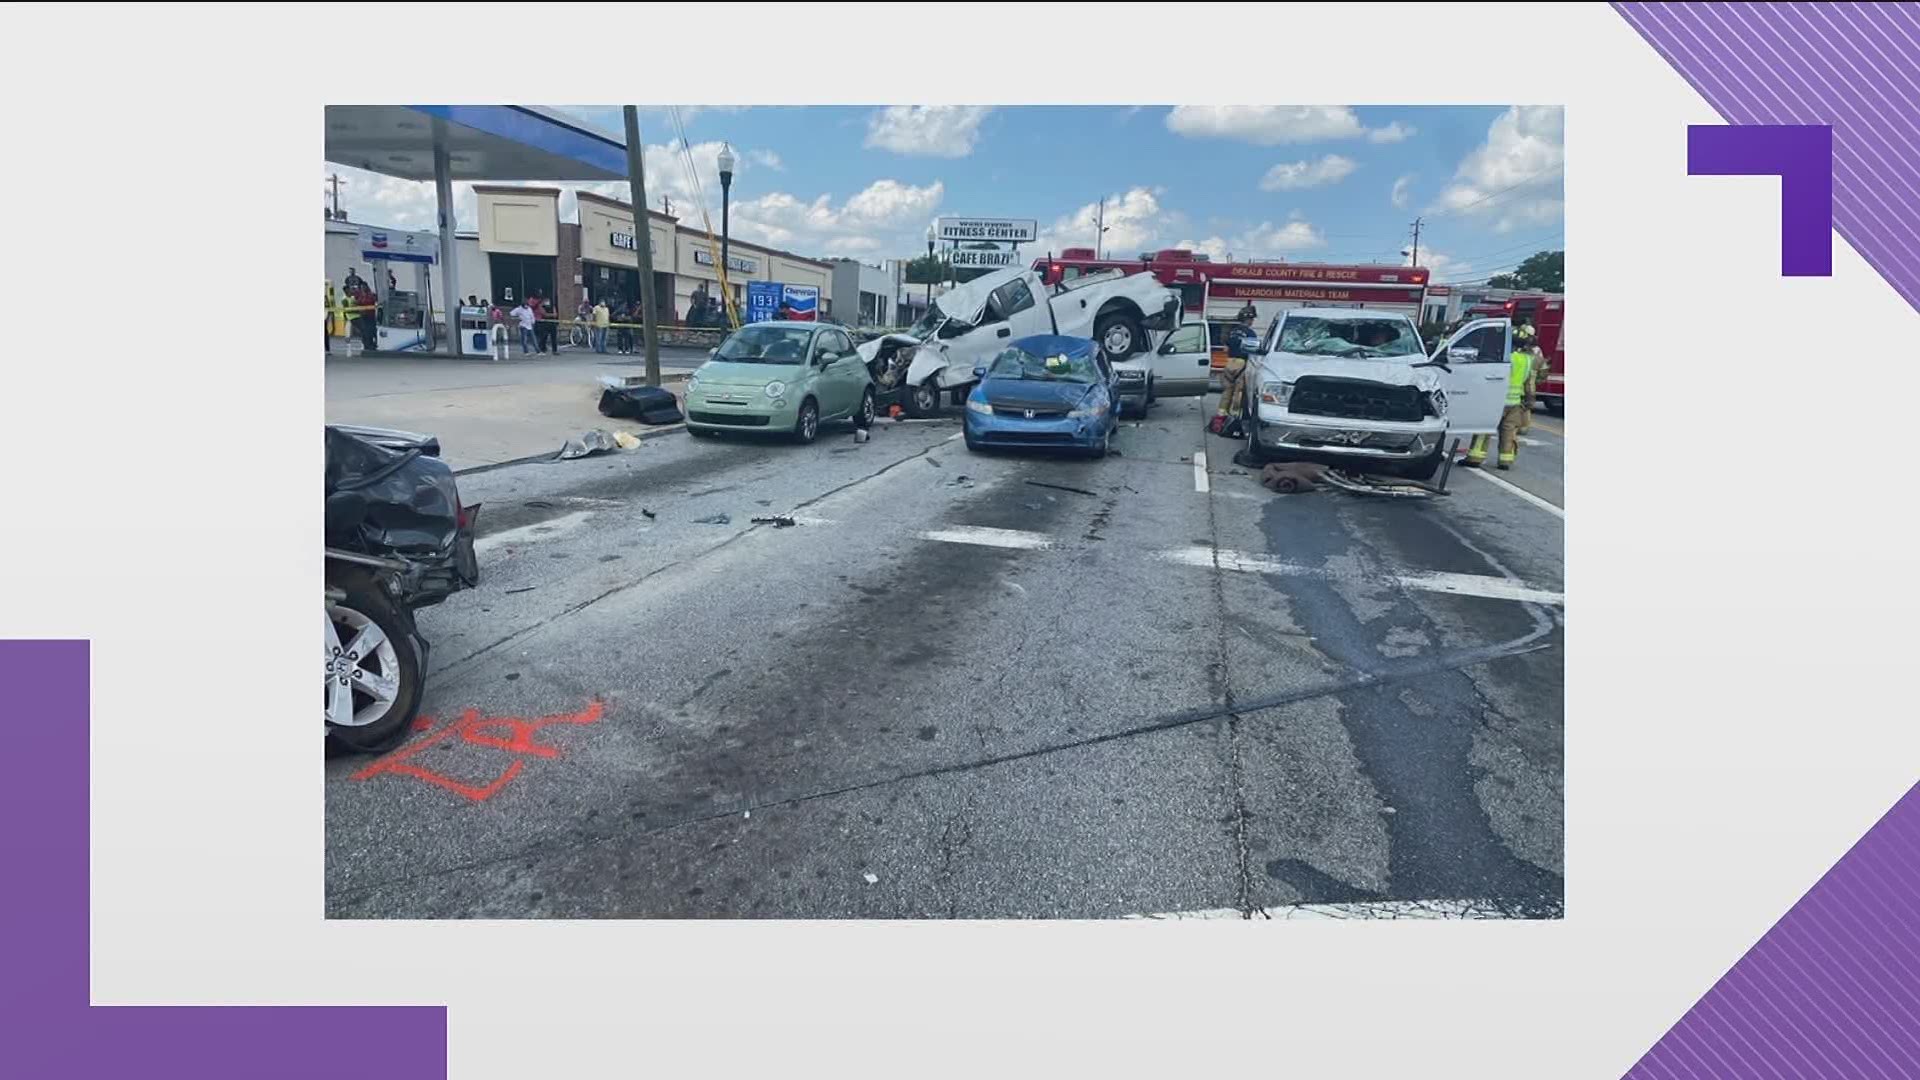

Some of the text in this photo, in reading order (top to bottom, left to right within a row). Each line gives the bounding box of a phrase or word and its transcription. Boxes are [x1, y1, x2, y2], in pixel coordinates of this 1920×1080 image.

[944, 227, 1028, 238] FITNESS CENTER
[406, 235, 414, 245] 2
[952, 252, 1013, 265] CAFE BRAZI
[1232, 267, 1263, 276] DEKALB
[1265, 268, 1296, 277] COUNTY
[1298, 269, 1316, 278] FIRE
[1326, 270, 1359, 279] RESCUE
[1235, 287, 1350, 299] HAZARDOUS MATERIALS TEAM
